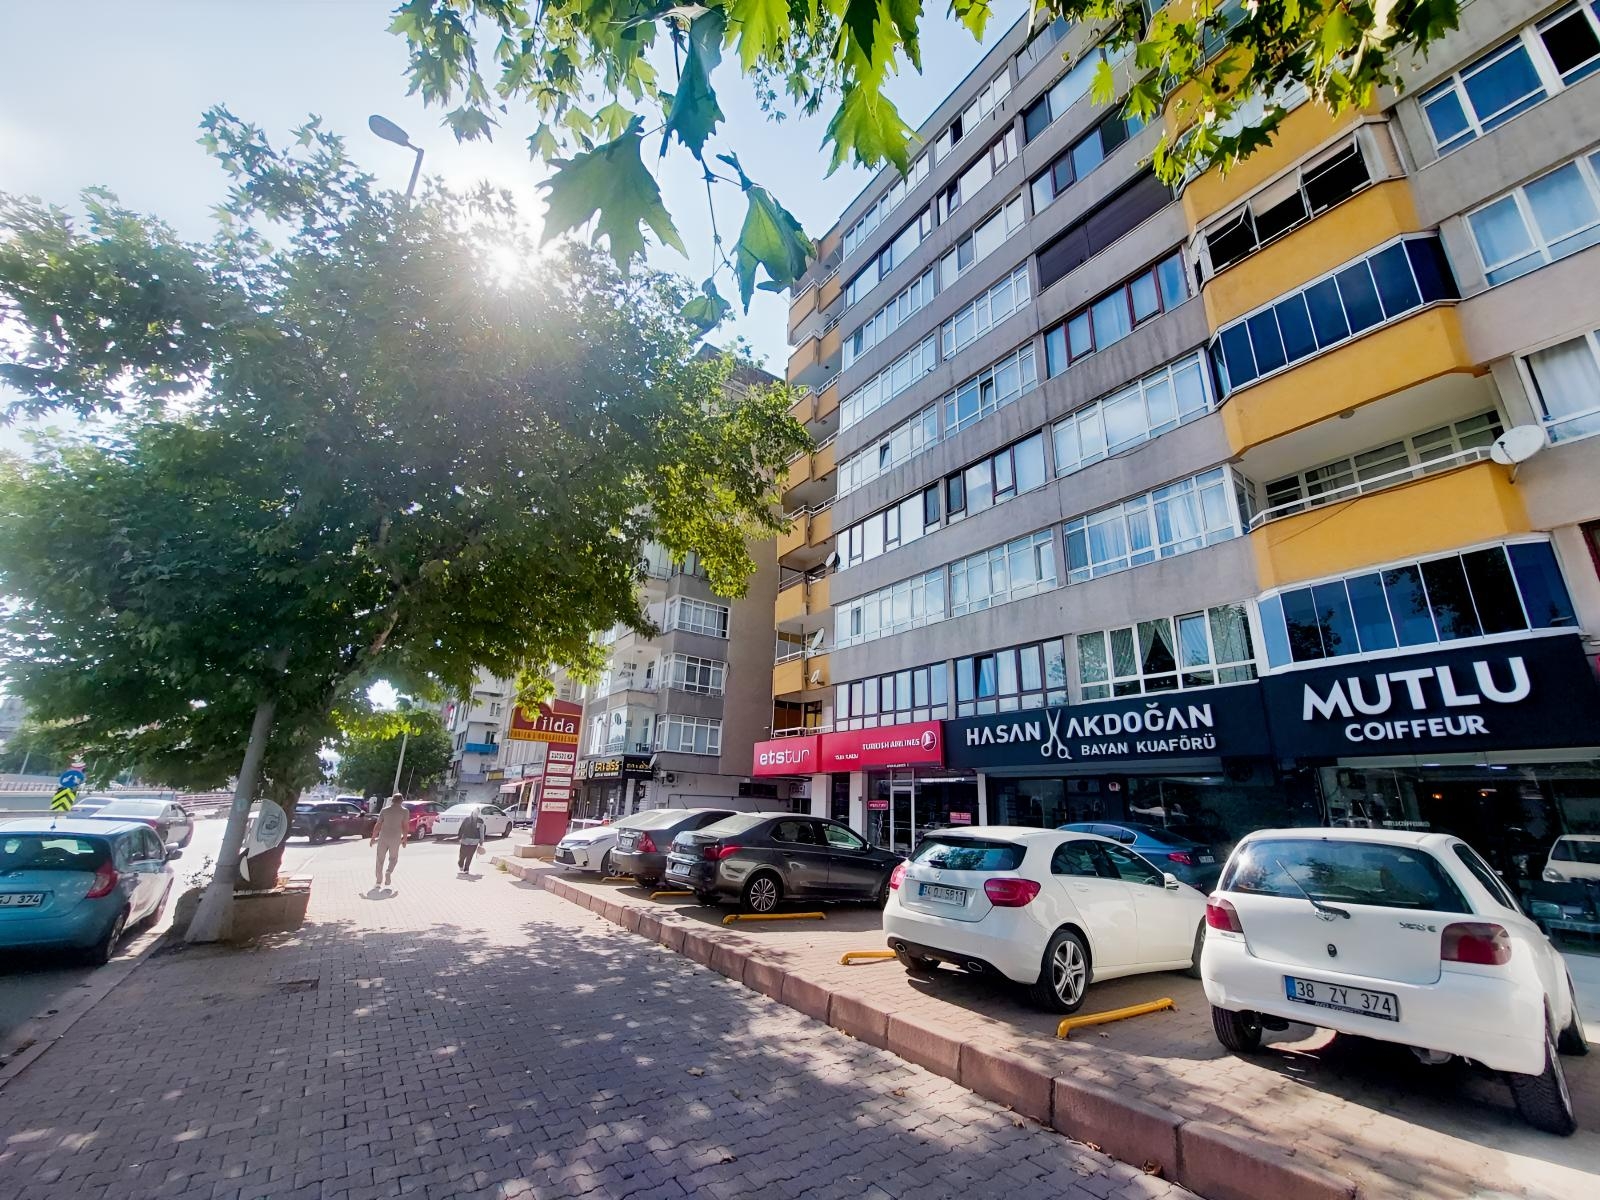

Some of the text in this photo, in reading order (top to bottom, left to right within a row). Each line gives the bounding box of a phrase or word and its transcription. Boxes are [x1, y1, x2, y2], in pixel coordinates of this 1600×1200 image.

[1302, 656, 1531, 721] MUTLU
[966, 702, 1214, 746] HASAN AKDOĞAN
[1345, 715, 1490, 742] COIFFEUR
[759, 749, 810, 766] etstur
[1081, 733, 1216, 756] BAYAN KUAFÖRÜ
[17, 894, 40, 904] 374
[1296, 981, 1315, 999] 38
[1329, 987, 1348, 1005] ZY
[1360, 993, 1392, 1014] 374
